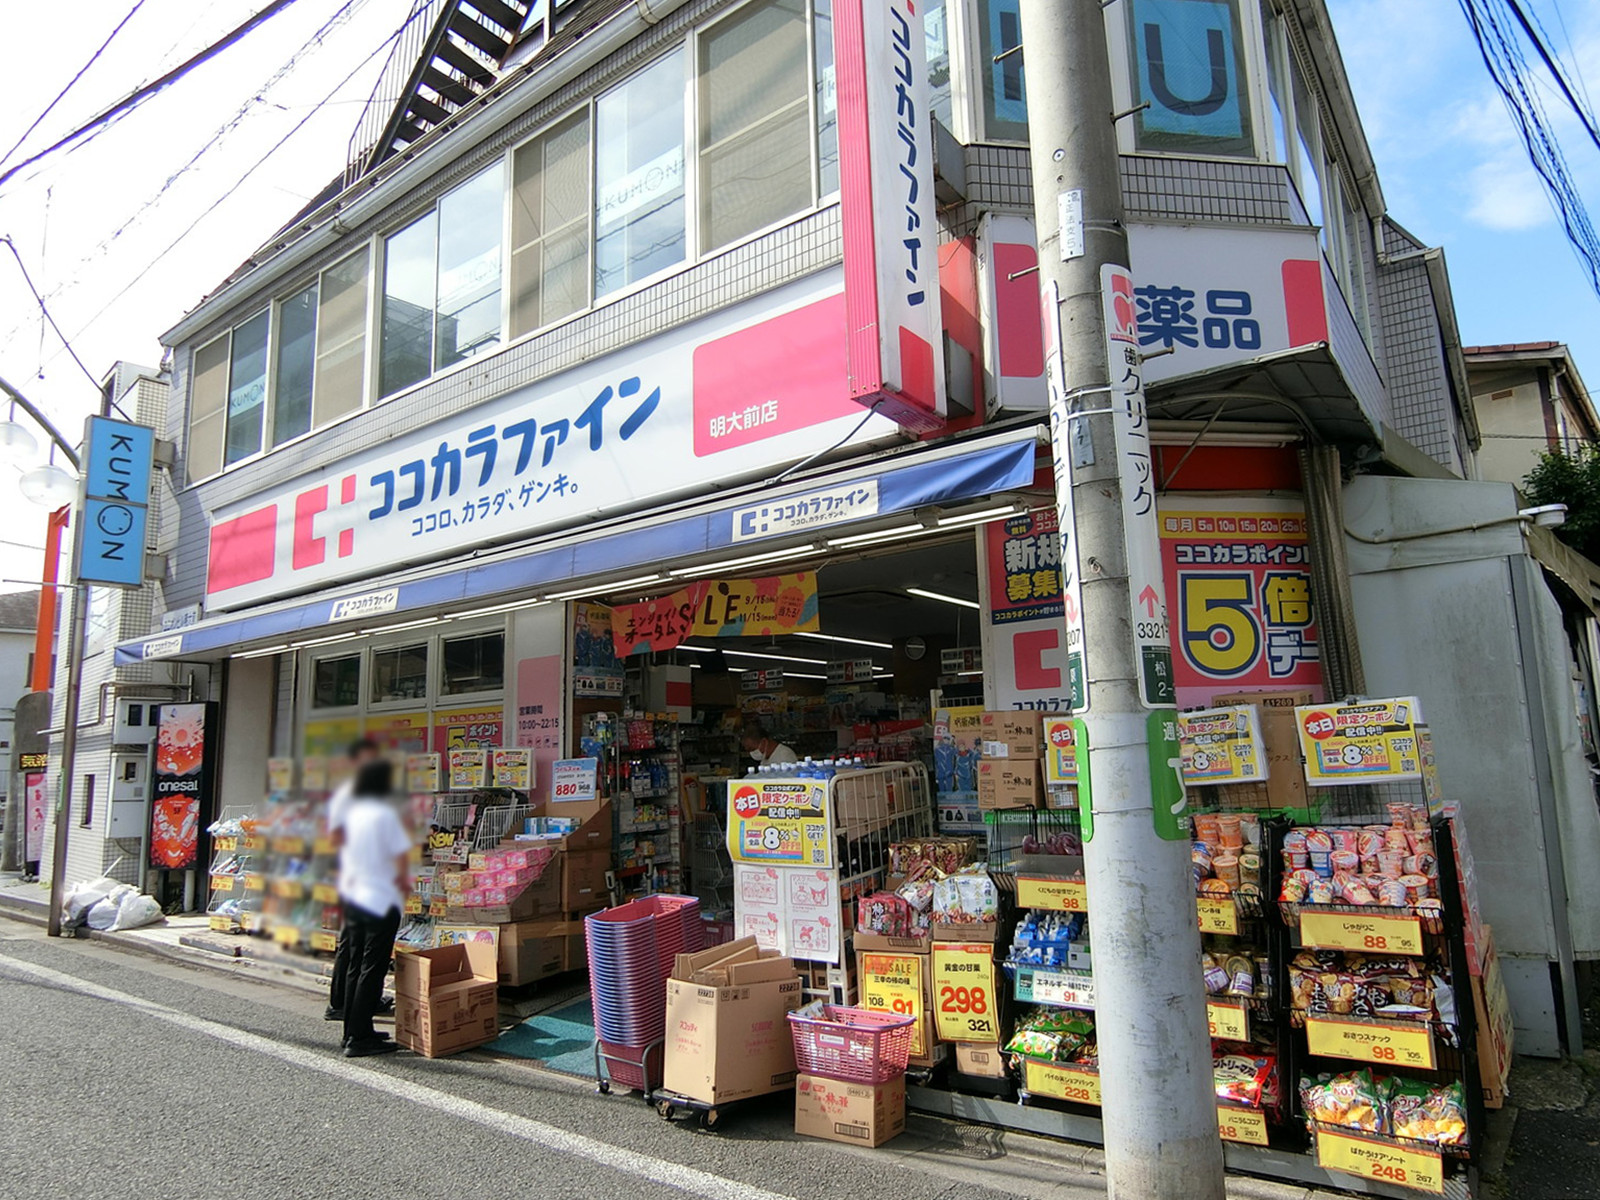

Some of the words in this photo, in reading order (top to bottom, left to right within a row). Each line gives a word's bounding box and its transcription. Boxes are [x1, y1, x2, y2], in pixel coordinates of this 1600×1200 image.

[1143, 22, 1229, 117] U
[890, 5, 925, 307] ココカラファイン
[1133, 284, 1262, 350] 薬品
[709, 400, 778, 438] 明大前店
[1121, 346, 1152, 516] 歯クリニック
[368, 375, 662, 521] ココカラファイン
[97, 433, 134, 561] KUMON
[410, 473, 579, 538] ココロ、カラダ、ゲンキ。
[773, 488, 870, 522] ココカラファイン
[1165, 518, 1193, 532] 毎月
[1007, 569, 1064, 602] 募集
[1180, 573, 1261, 677] 5
[1263, 573, 1313, 627] 倍
[518, 704, 543, 716] 営業時間
[1305, 717, 1334, 735] 本日
[1336, 711, 1393, 726] 限定クーポン
[469, 723, 498, 736] ポイント
[1187, 721, 1235, 734] 限定クーポン
[1344, 725, 1384, 738] 配信中!!
[1051, 729, 1072, 744] 本日
[556, 783, 577, 796] 880
[735, 794, 759, 812] 本日
[762, 792, 810, 805] 限定クーポン
[768, 806, 801, 819] 配信中!!
[805, 824, 825, 832] ココカラ
[1062, 897, 1080, 909] 98
[1342, 922, 1375, 932] じゃがりこ
[1363, 935, 1388, 949] 88
[1401, 939, 1412, 948] 95
[940, 985, 988, 1015] 298
[1063, 990, 1076, 1003] 91
[868, 996, 884, 1007] 108
[892, 998, 913, 1015] 91
[967, 1018, 992, 1032] 321
[1342, 1030, 1391, 1044] おさつスナック
[1371, 1045, 1396, 1061] 98
[1407, 1051, 1421, 1060] 105
[1065, 1086, 1090, 1101] 228
[1350, 1146, 1406, 1165] ばかうけアソート
[1371, 1162, 1408, 1182] 248
